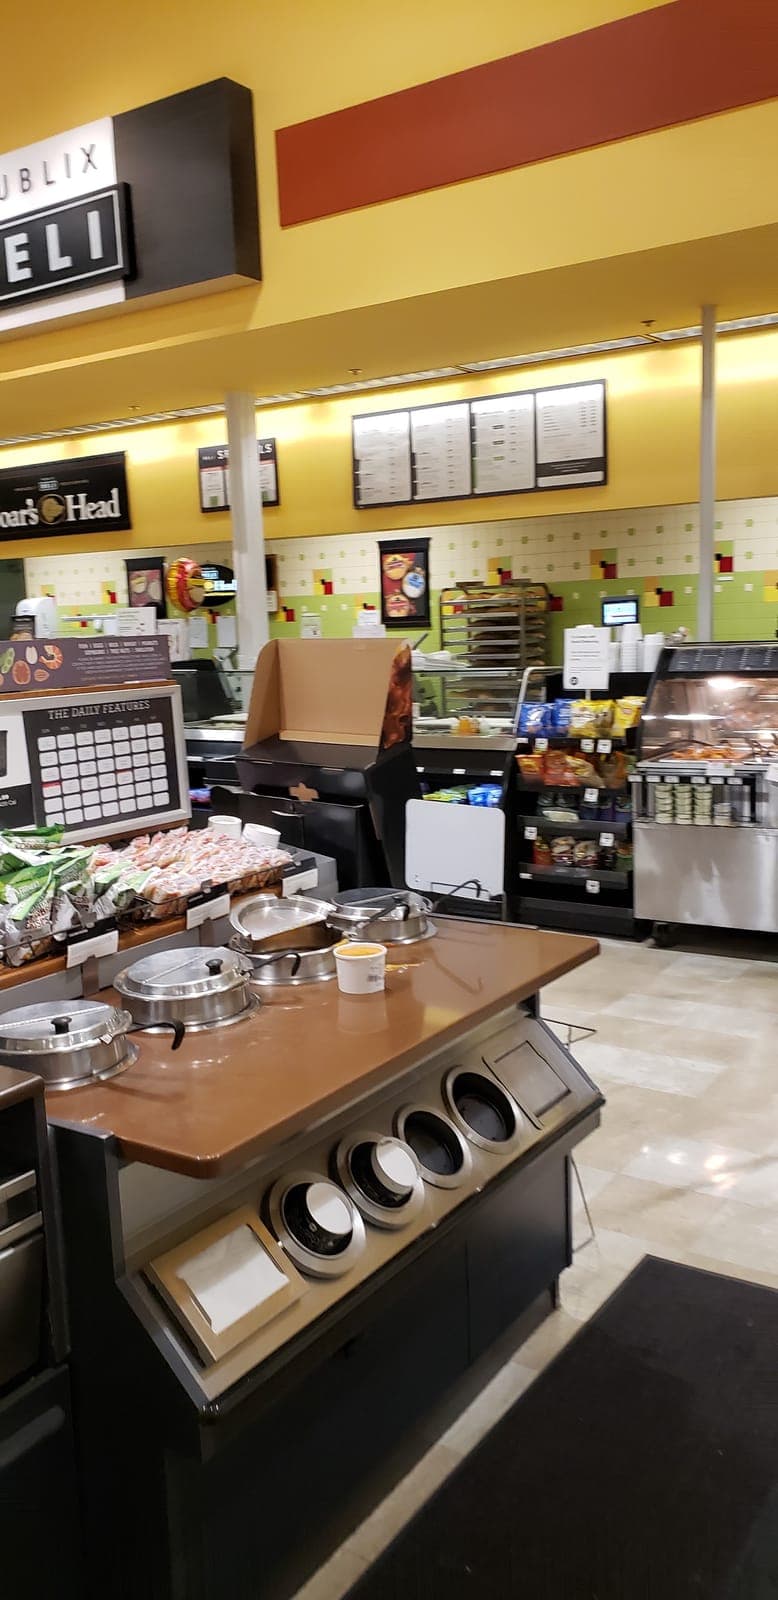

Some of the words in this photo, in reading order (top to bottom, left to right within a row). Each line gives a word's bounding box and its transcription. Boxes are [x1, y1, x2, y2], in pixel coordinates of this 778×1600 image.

[4, 210, 103, 283] ELI
[65, 487, 121, 521] Head
[48, 709, 70, 720] THE
[72, 705, 100, 717] DAILY
[102, 700, 151, 714] FEATURES
